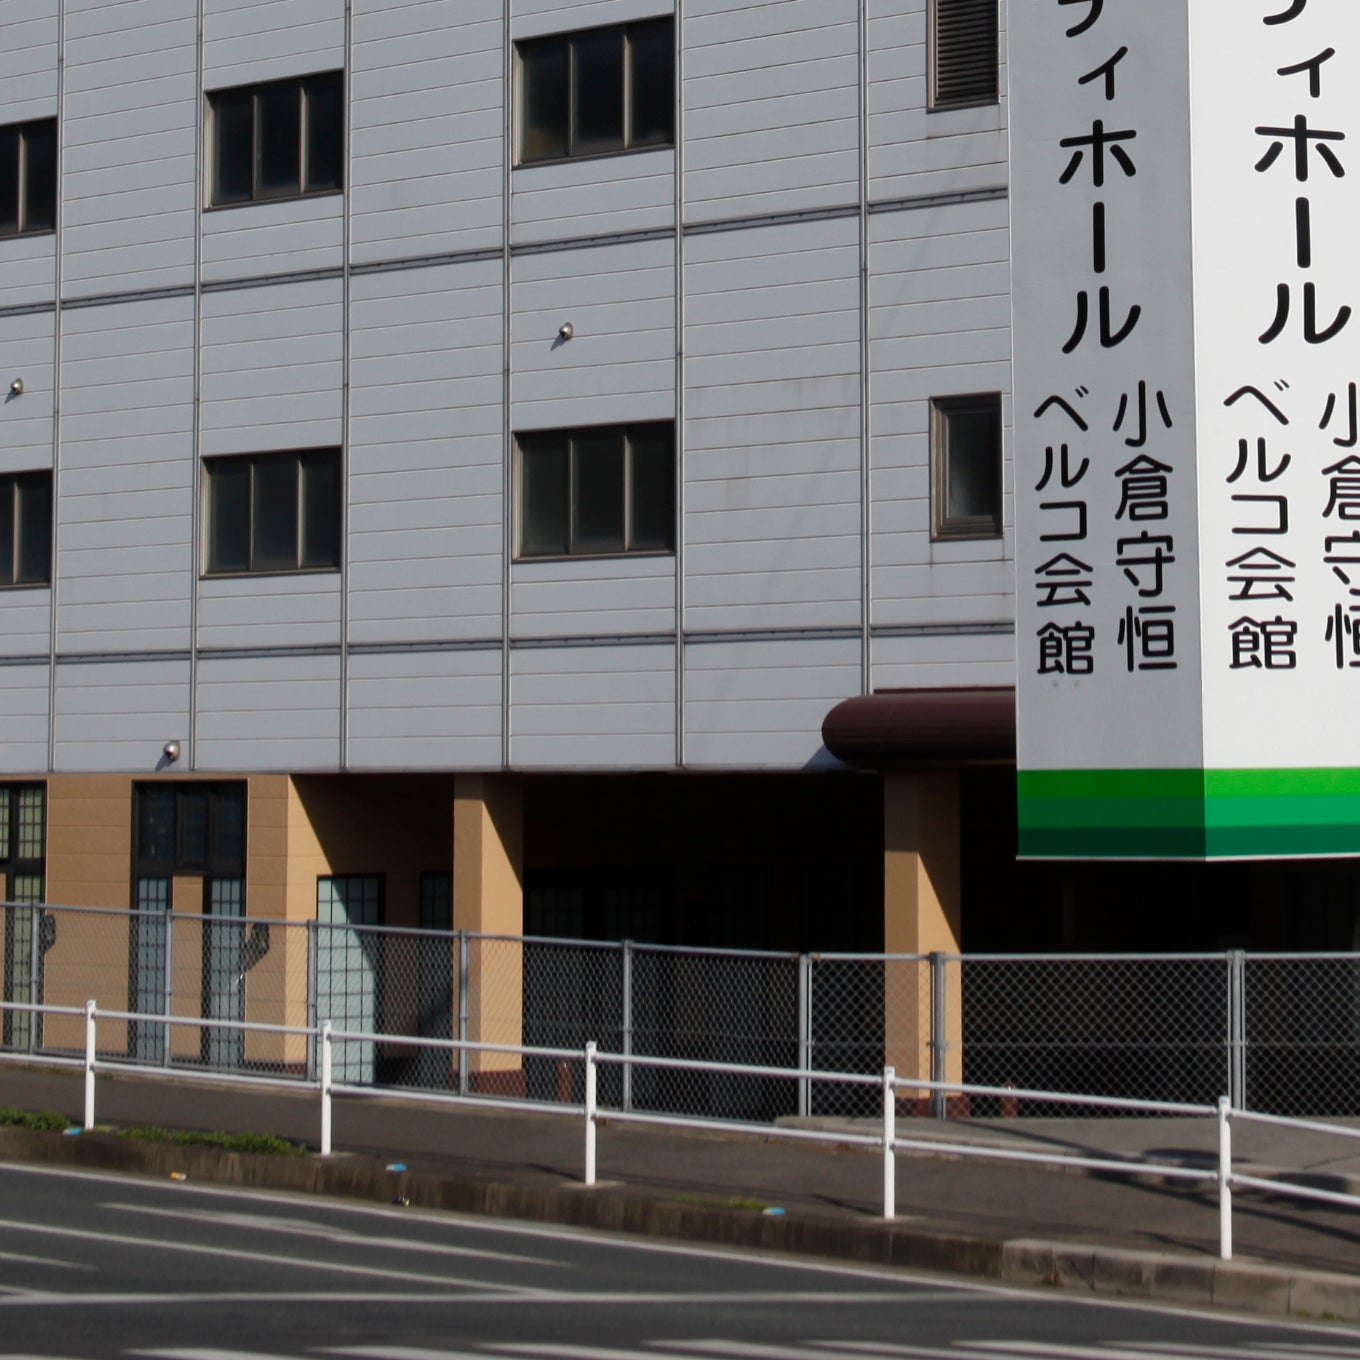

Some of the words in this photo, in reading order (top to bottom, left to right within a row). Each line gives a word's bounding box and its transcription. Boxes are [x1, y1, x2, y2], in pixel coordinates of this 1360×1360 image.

[1034, 385, 1096, 675] ベルコ会館
[1113, 380, 1178, 672] 小倉守恒
[1223, 378, 1298, 670] ベルコ会館
